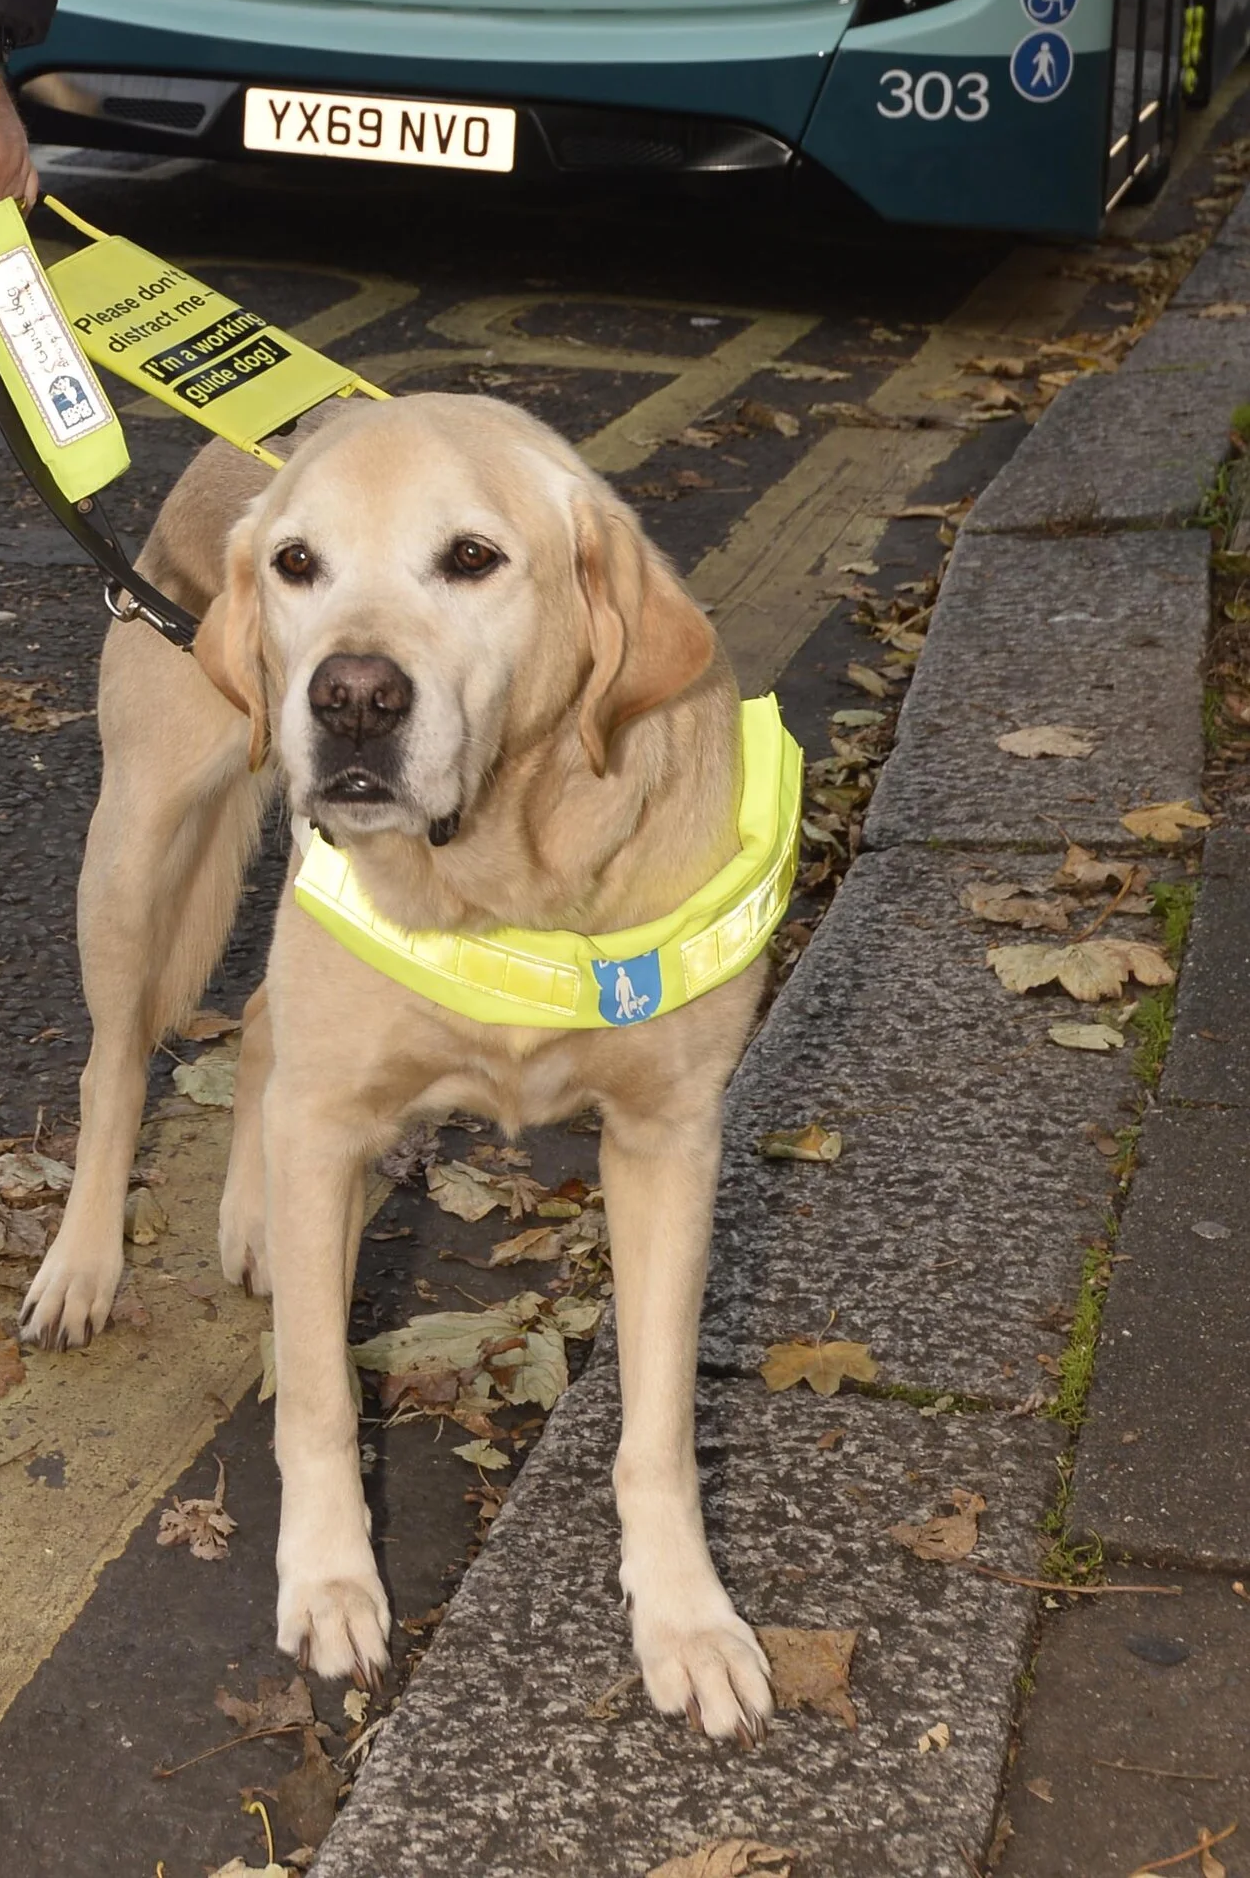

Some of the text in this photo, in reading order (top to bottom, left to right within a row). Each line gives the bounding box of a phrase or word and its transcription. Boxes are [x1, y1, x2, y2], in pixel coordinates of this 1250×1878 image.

[876, 68, 990, 122] 303
[268, 98, 491, 158] YX69 NVO
[73, 296, 141, 335] Please
[137, 269, 188, 302] don't
[108, 309, 179, 353] distract
[173, 293, 207, 317] me
[144, 310, 268, 380] I'm a working
[184, 338, 279, 404] guide dog!
